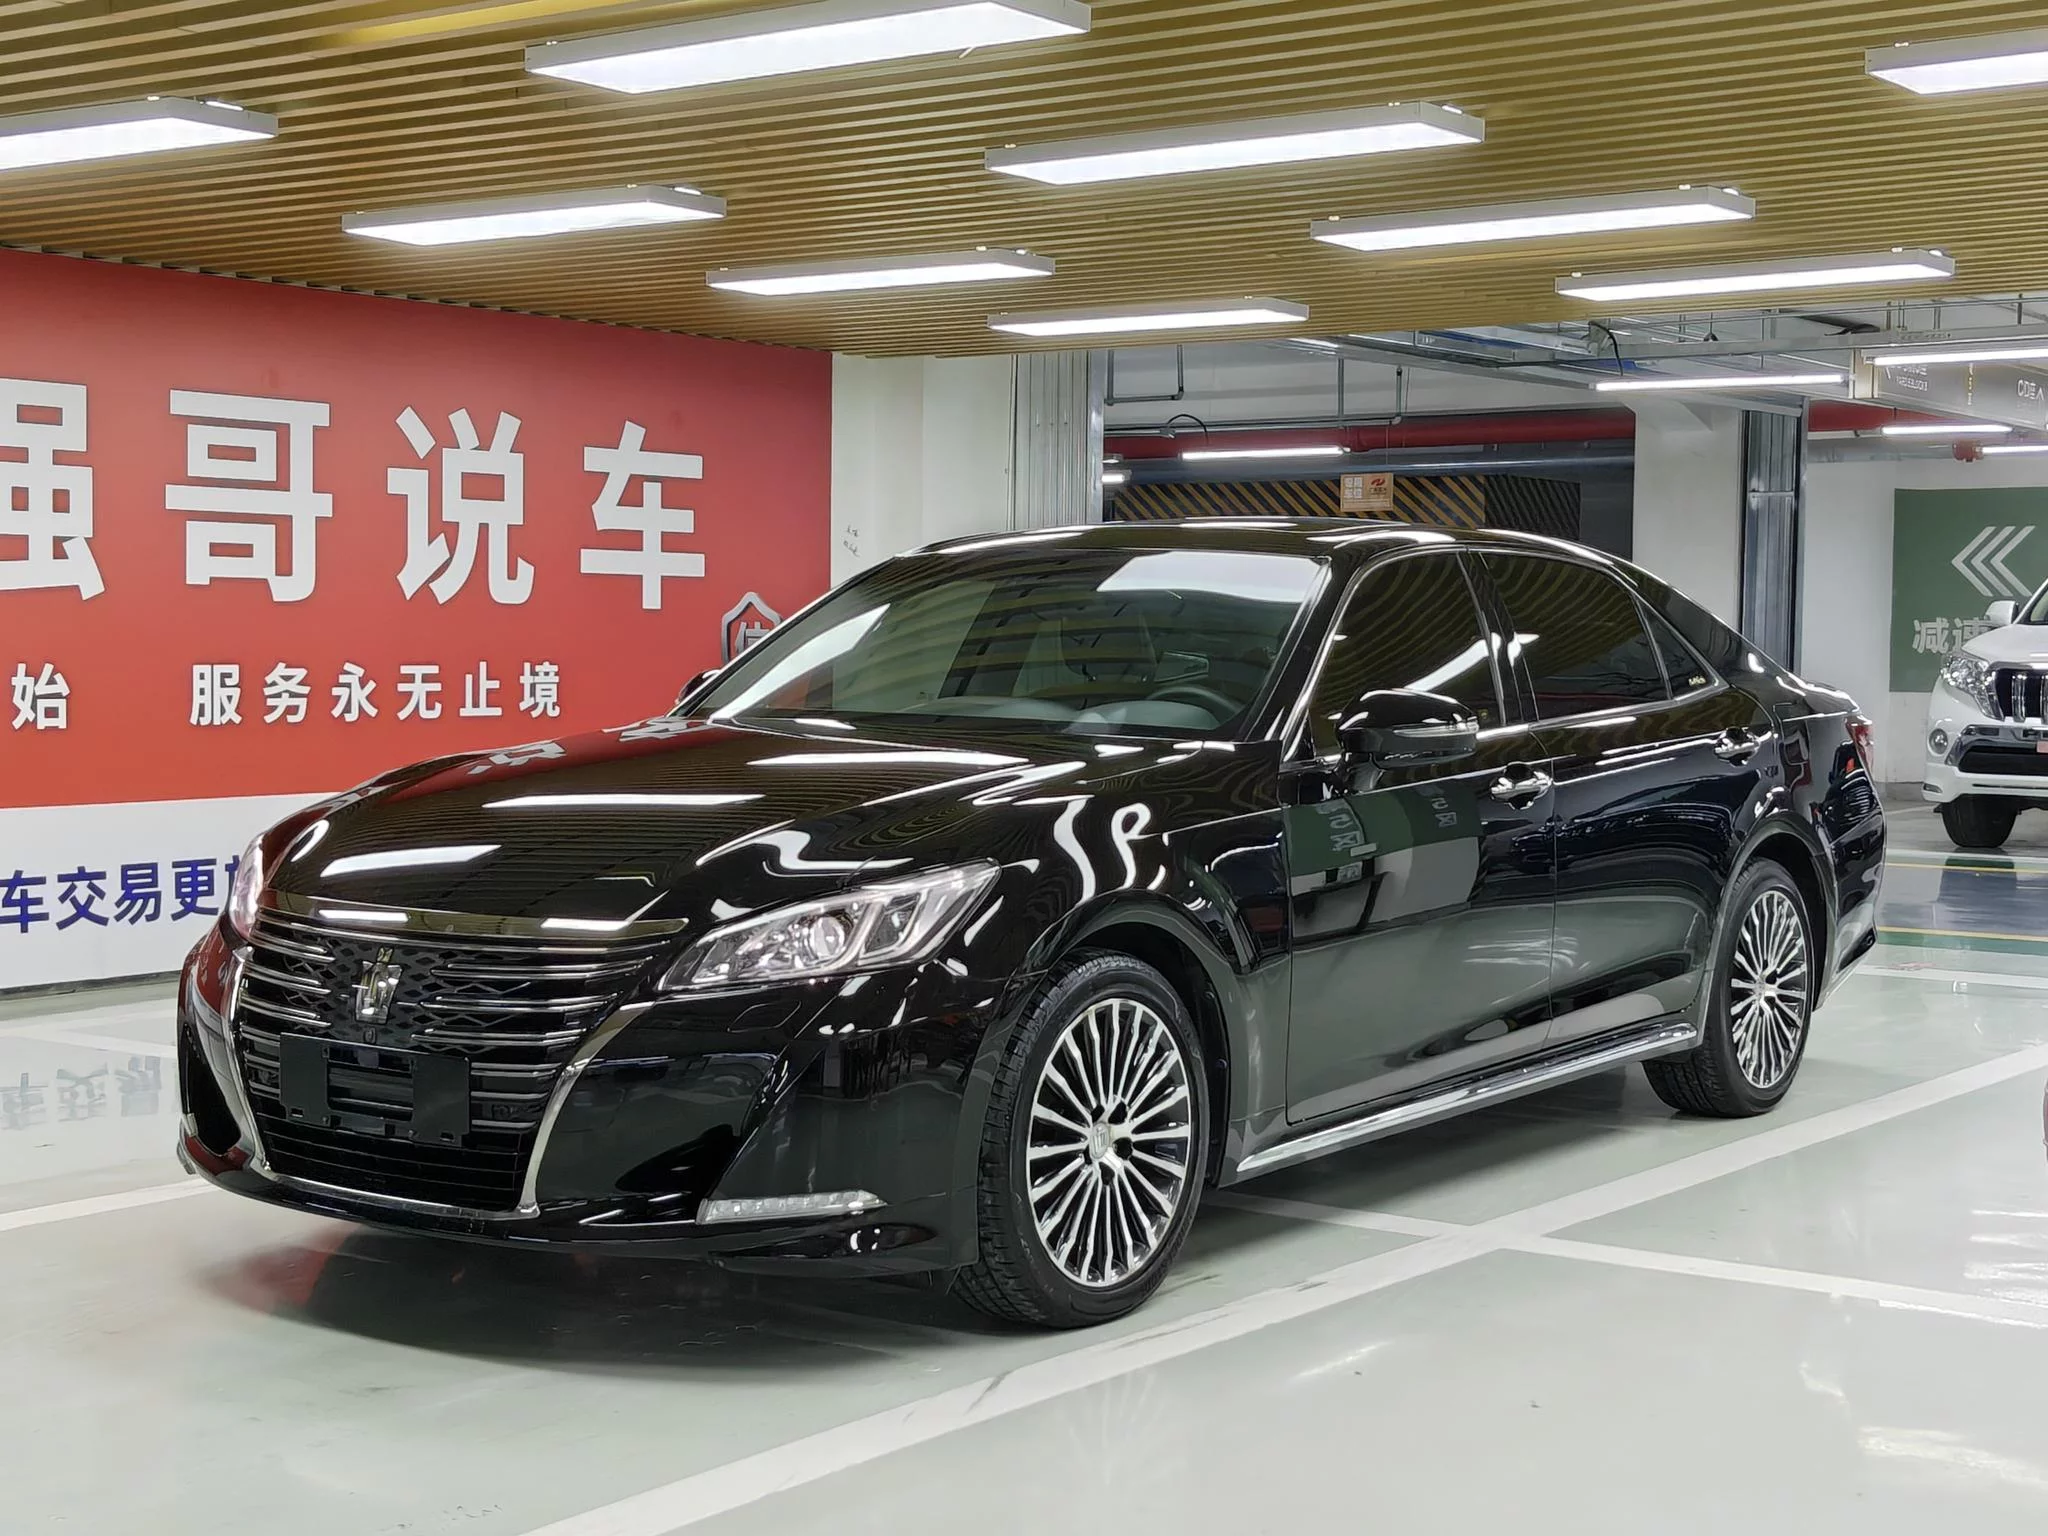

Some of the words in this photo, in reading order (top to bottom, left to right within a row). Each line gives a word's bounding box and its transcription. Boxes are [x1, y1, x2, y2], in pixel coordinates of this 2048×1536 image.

[12, 662, 70, 730] 始
[190, 661, 562, 727] 服务永无止境
[0, 855, 238, 933] 车交易更
